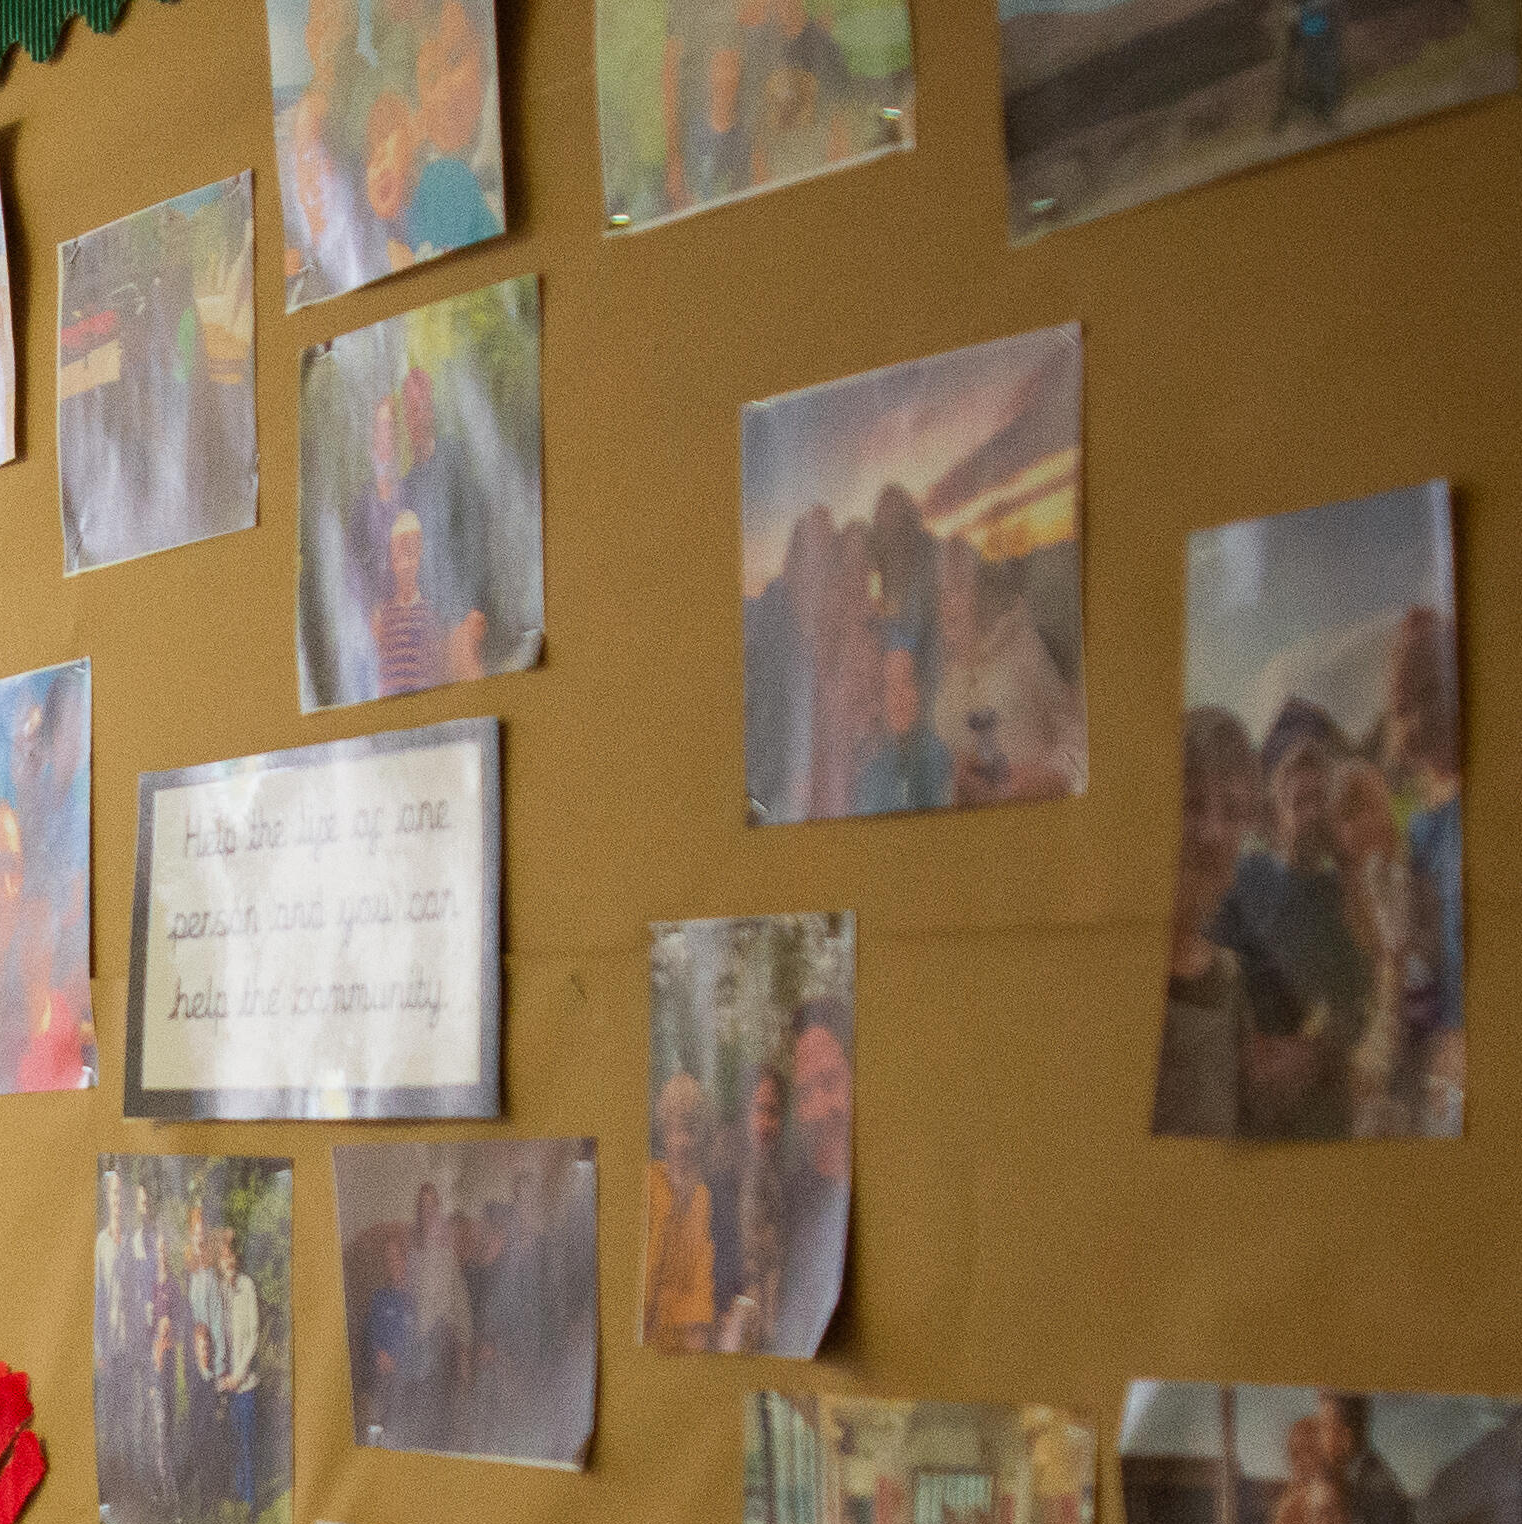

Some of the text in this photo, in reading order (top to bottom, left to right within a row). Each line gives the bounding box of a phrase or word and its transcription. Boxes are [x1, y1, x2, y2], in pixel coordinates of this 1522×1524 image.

[394, 797, 452, 834] one
[167, 900, 260, 958] person
[167, 972, 230, 1036] help
